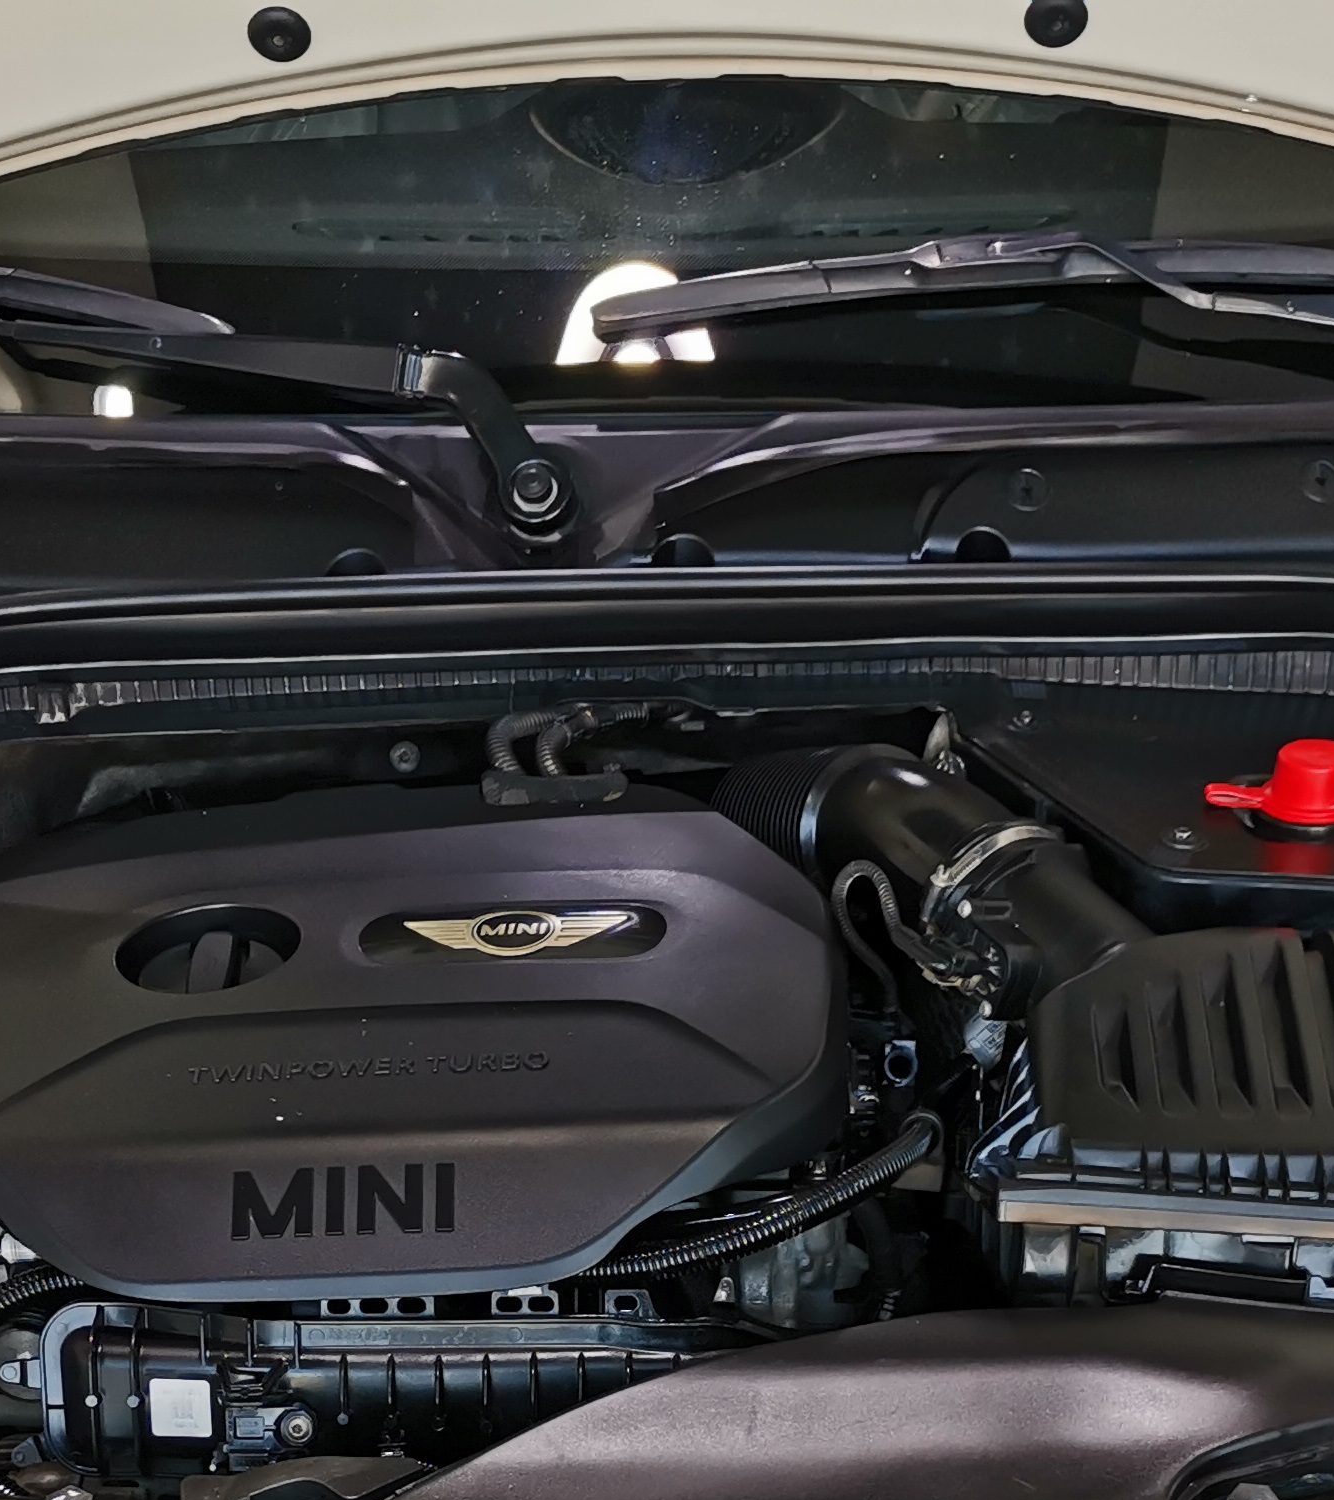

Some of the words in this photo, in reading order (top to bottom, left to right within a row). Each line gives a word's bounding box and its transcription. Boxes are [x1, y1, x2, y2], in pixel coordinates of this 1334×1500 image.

[479, 922, 548, 937] MINI
[187, 1056, 417, 1085] TWINPOWER
[426, 1050, 550, 1074] TURBO
[231, 1162, 455, 1241] MINI
